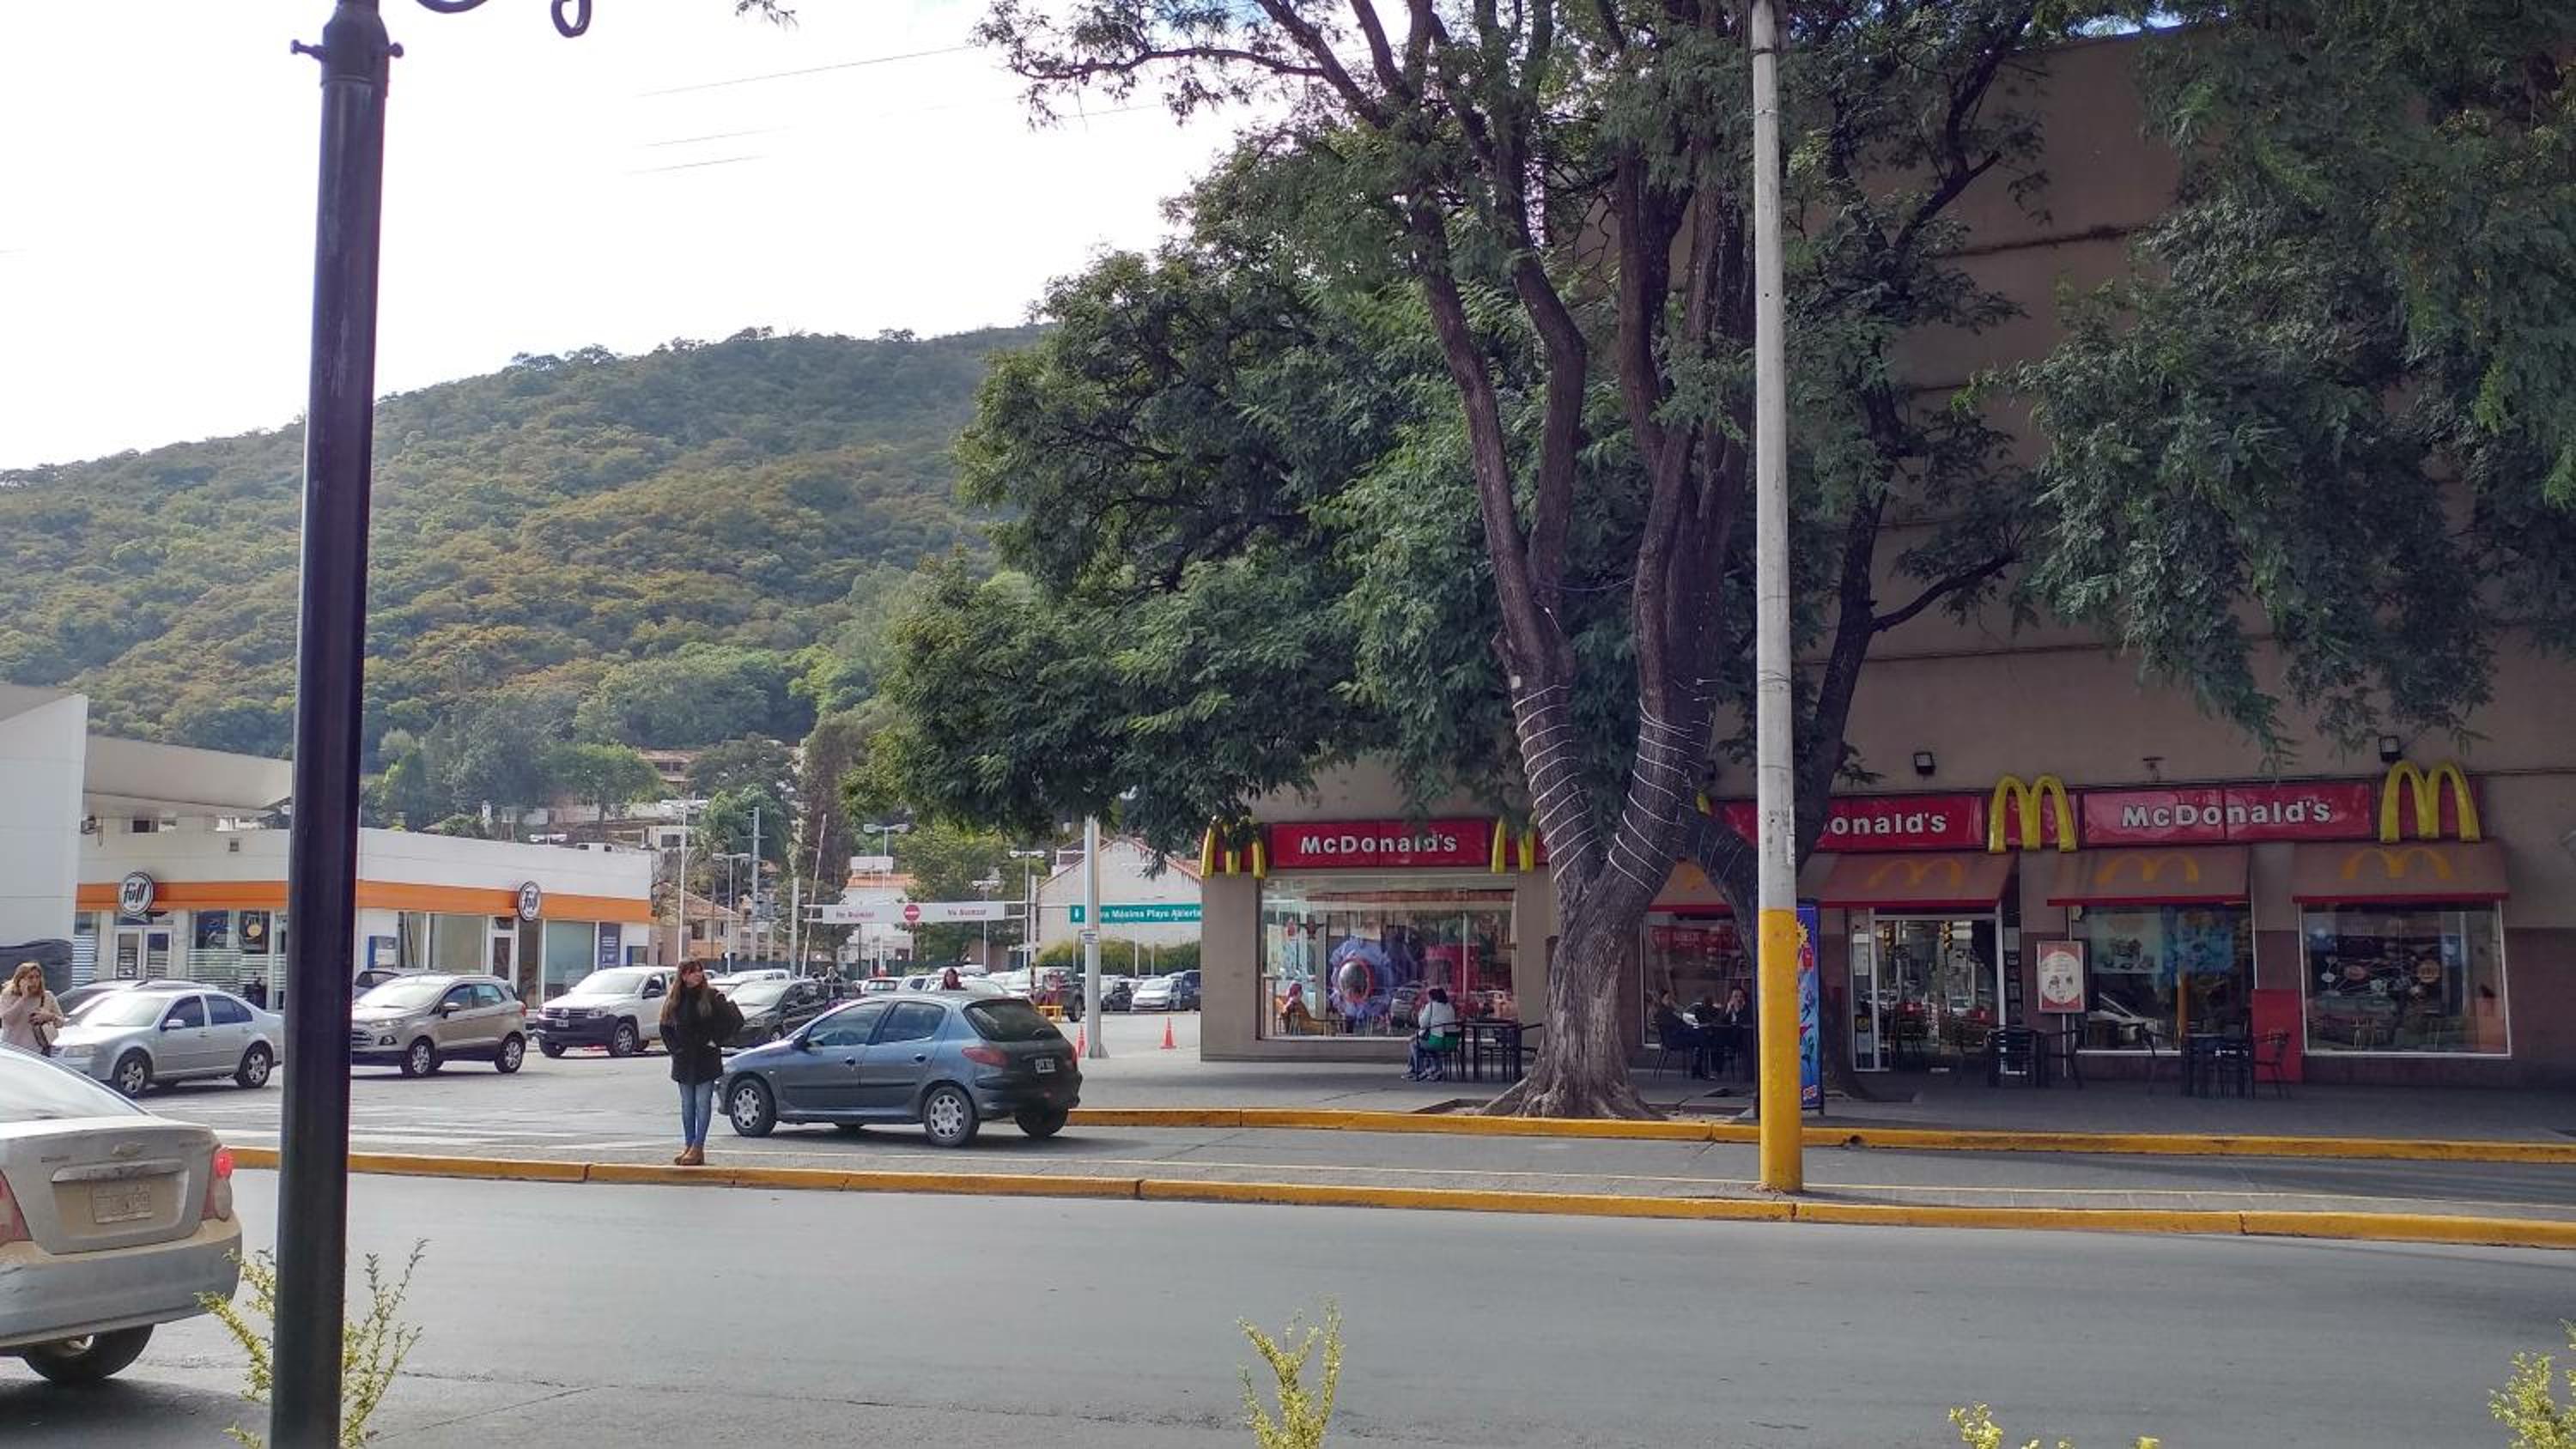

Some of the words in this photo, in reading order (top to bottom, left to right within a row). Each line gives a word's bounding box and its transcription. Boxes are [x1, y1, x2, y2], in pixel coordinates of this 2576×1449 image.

[1824, 813, 1947, 834] onald's
[2122, 801, 2331, 827] McDonald's
[1300, 834, 1457, 854] McDonald's
